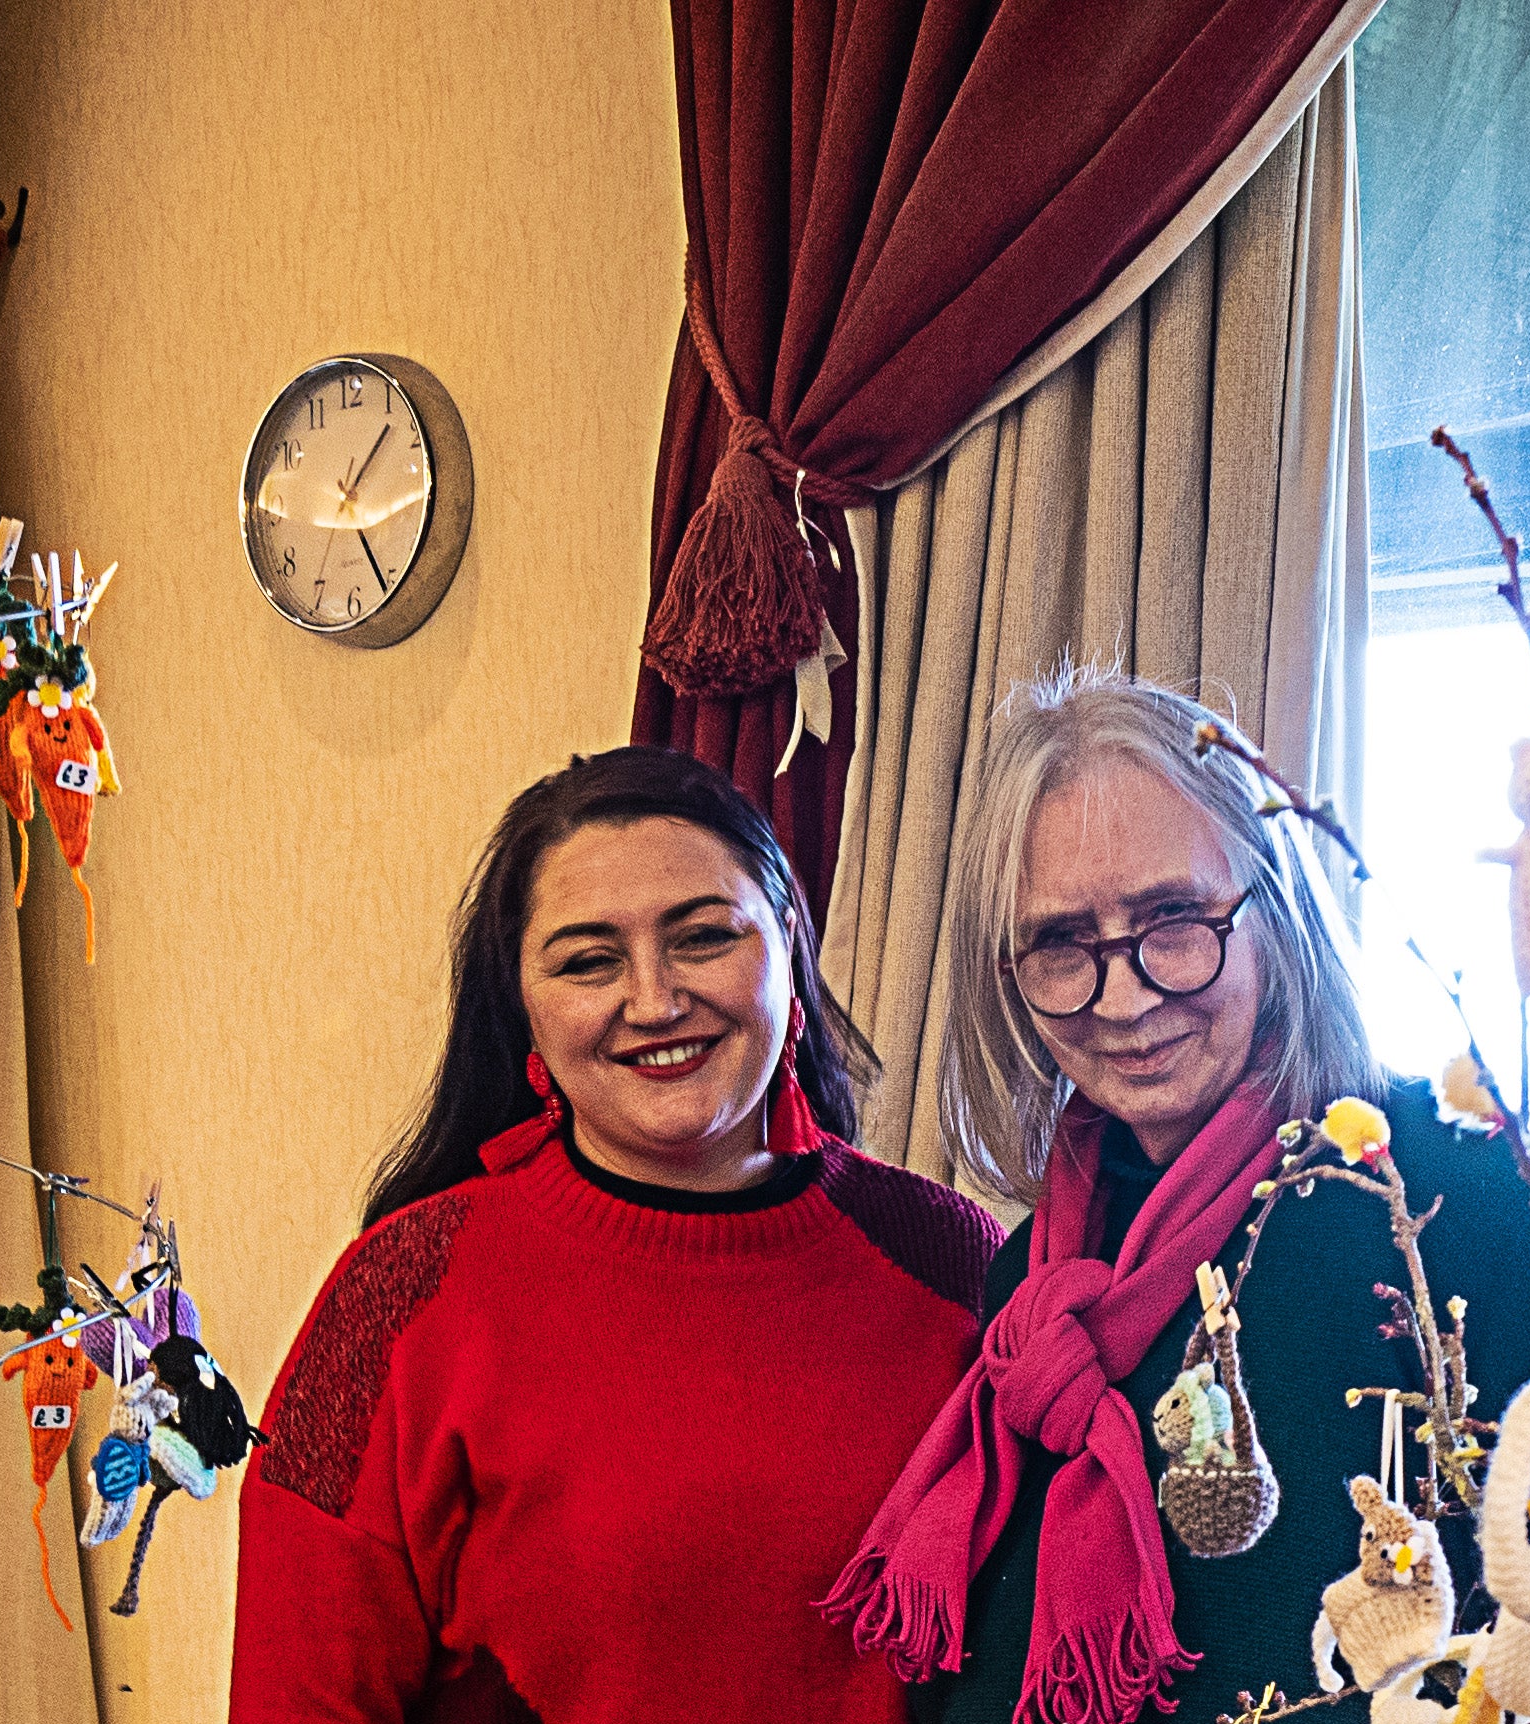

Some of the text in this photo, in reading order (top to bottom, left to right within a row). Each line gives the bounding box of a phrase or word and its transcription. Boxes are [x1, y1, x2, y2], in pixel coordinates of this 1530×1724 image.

[340, 375, 362, 410] 12
[385, 383, 392, 414] 1
[308, 399, 325, 430] 11
[283, 438, 301, 472] 10
[284, 547, 296, 579] 8
[315, 580, 326, 611] 7
[347, 586, 361, 619] 6
[64, 764, 89, 787] £3
[35, 1407, 66, 1428] £3
